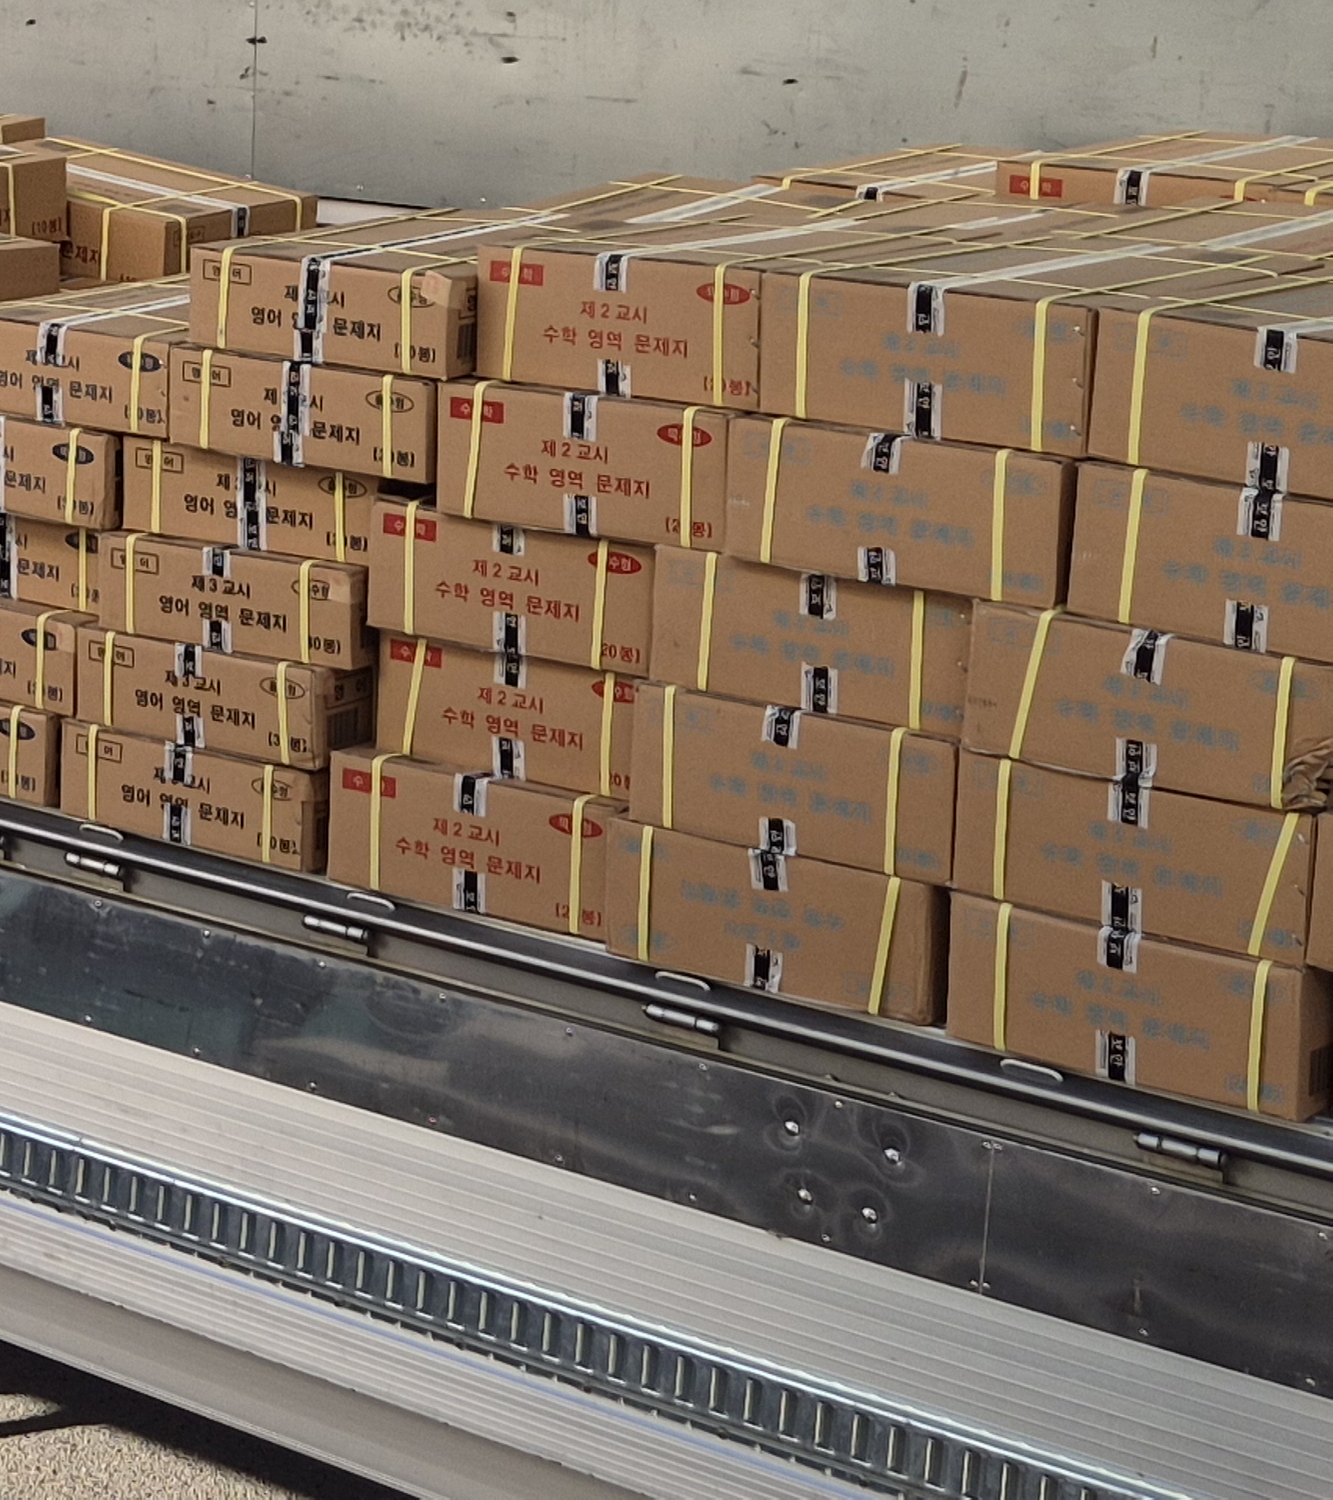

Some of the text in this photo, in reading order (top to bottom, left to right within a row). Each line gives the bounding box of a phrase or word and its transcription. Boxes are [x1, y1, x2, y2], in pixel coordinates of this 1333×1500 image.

[251, 306, 381, 341] 영어 문제지
[580, 301, 647, 324] 제 2 교시
[543, 325, 688, 358] 수학 영역 문제지
[70, 381, 113, 404] 문제지
[264, 387, 278, 405] 제
[231, 409, 360, 444] 영어 문제지
[541, 440, 609, 464] 제 2 교시
[4, 470, 47, 493] 문제지
[216, 473, 230, 490] 제
[504, 462, 650, 499] 수학 영역 문제지
[184, 493, 313, 530] 영어 문제지
[17, 558, 59, 582] 문제지
[472, 560, 540, 587] 제 2 교시
[192, 576, 251, 599] 제 3 교시
[435, 581, 580, 622] 수학 영역 문제지
[159, 595, 287, 632] 영어 영역 문제지
[193, 677, 221, 696] 교시
[477, 687, 544, 715] 제 2 교시
[135, 689, 256, 730] 영어 영역 문제지
[442, 707, 583, 751] 수학 영역 문제지
[121, 785, 245, 830] 영어 문제지
[433, 817, 500, 847] 제 2 교시
[395, 836, 541, 884] 수학 영역 문제지
